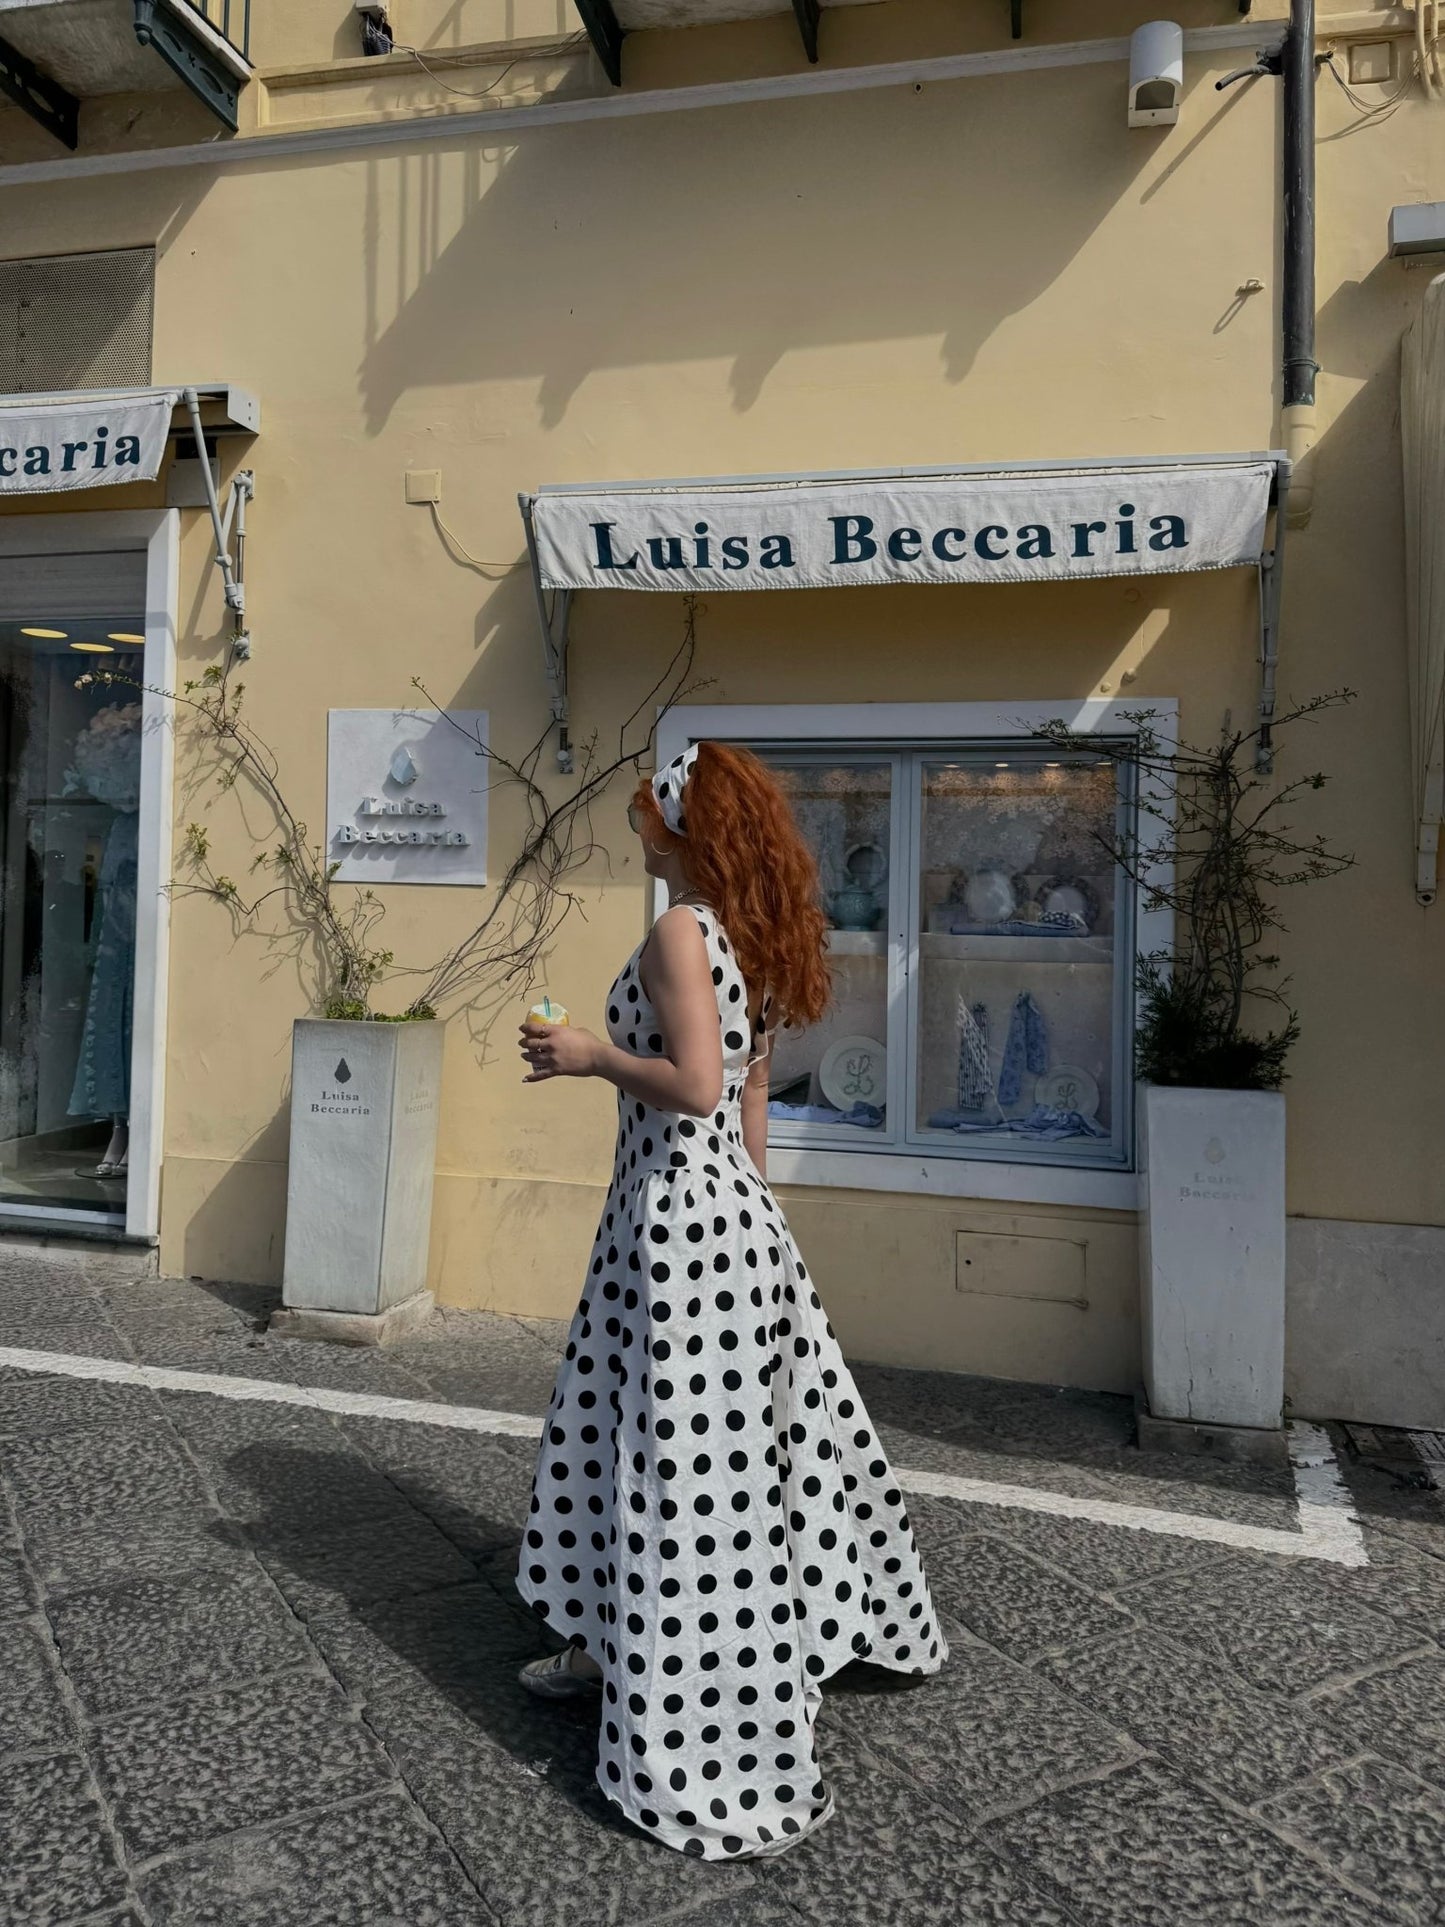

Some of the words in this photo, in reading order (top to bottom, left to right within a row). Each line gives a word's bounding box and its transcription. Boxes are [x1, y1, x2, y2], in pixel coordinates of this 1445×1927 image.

[589, 521, 796, 571] Luisa
[828, 503, 1190, 565] Beccaria
[360, 797, 446, 817] Luisa
[337, 825, 471, 847] Beccaria
[321, 1091, 360, 1101] Luisa
[311, 1103, 370, 1115] Beccaria
